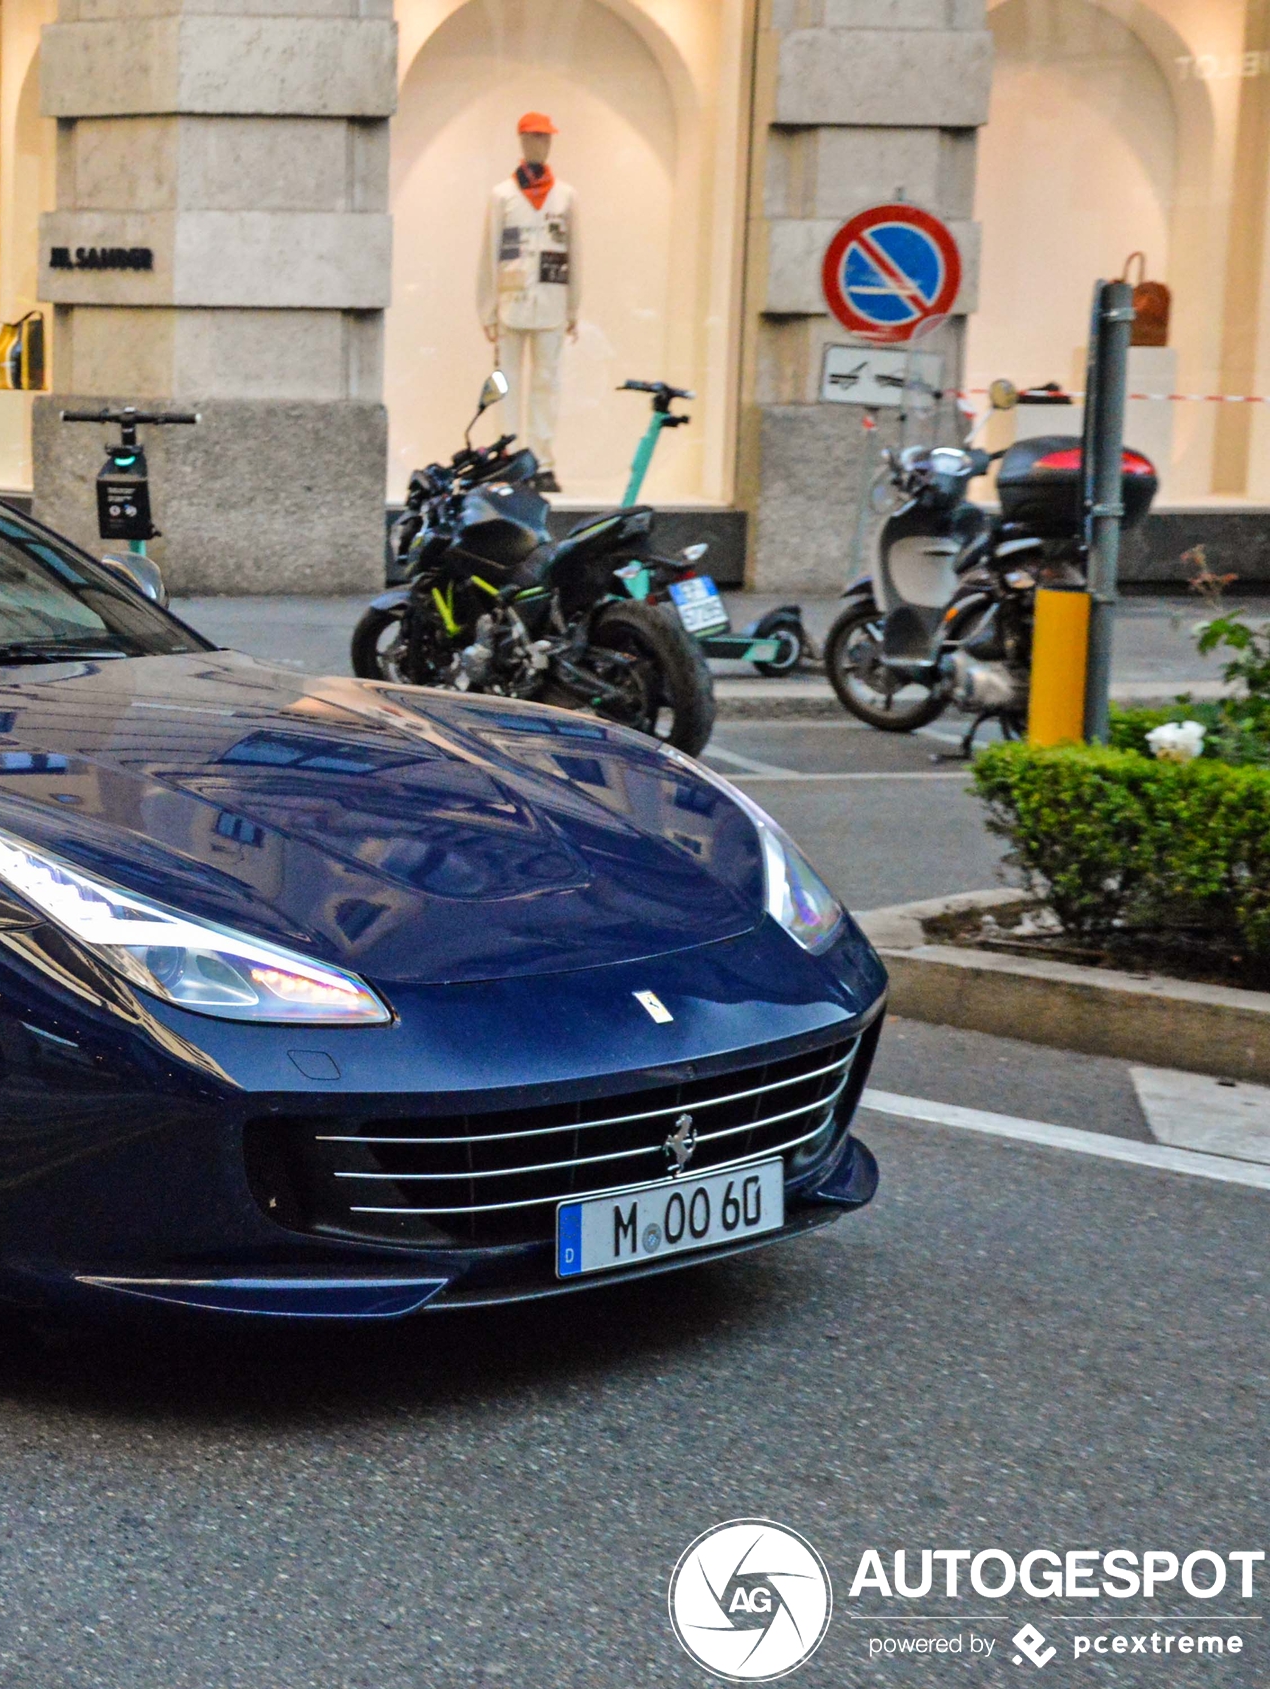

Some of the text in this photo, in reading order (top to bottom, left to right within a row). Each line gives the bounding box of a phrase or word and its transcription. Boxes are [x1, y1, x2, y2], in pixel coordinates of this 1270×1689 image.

[614, 1201, 638, 1257] M
[721, 1175, 762, 1232] 60
[565, 1248, 575, 1264] D
